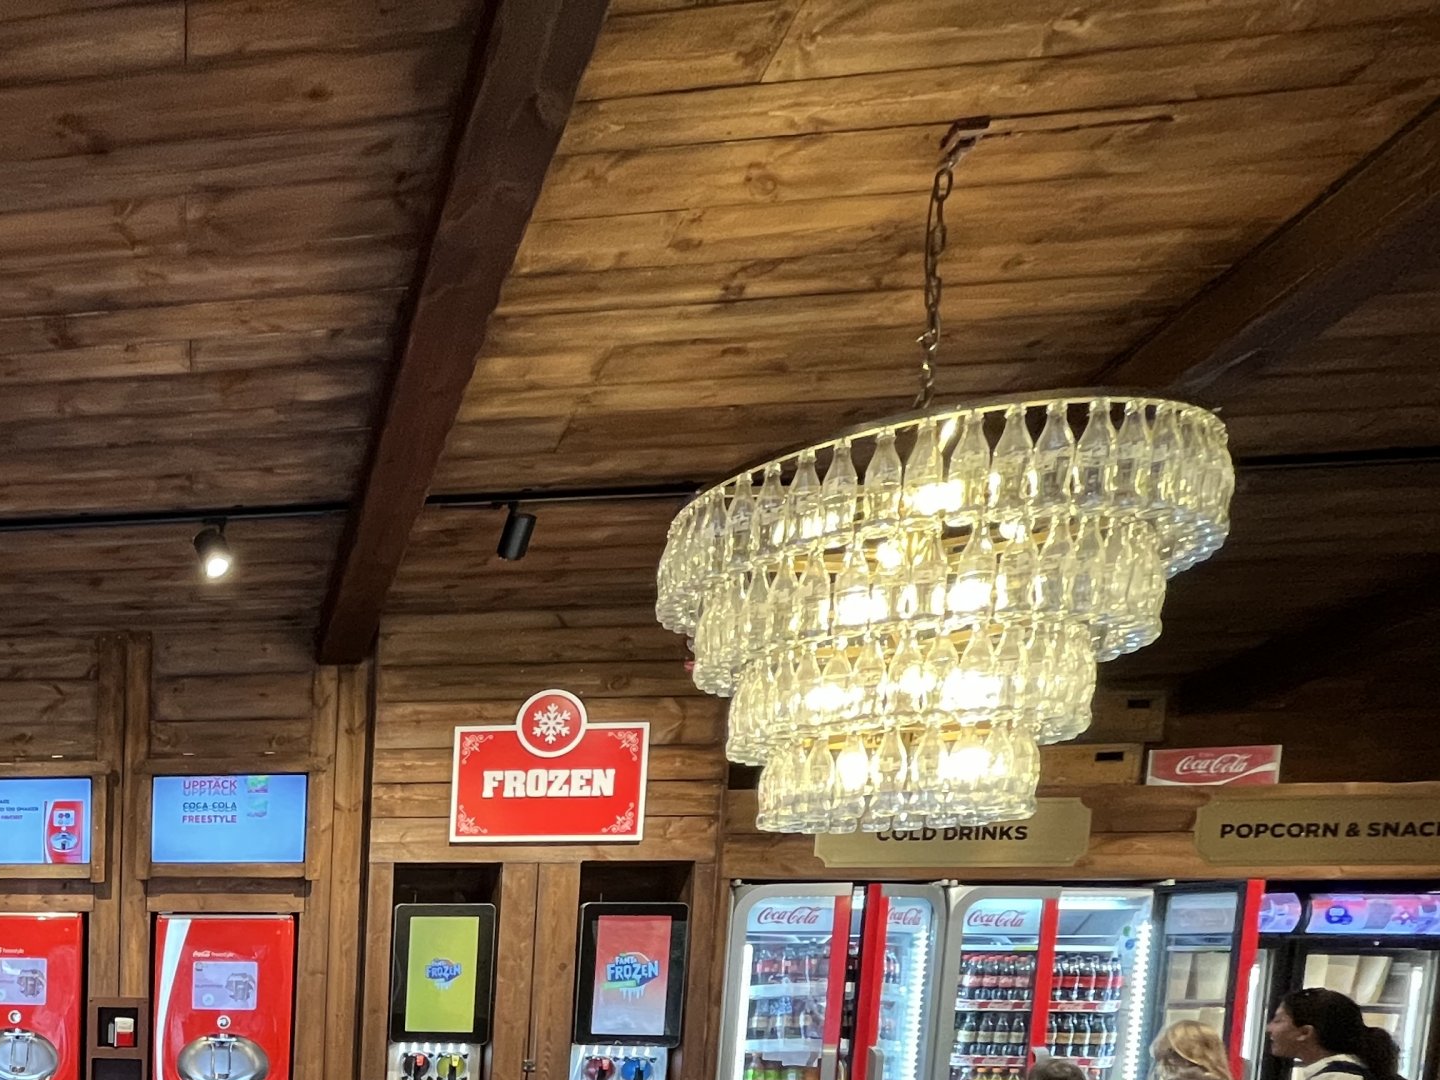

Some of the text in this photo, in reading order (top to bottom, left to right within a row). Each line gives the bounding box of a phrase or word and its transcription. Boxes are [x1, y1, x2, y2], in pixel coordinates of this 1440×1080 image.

[1175, 753, 1253, 775] Coca-Cola
[183, 778, 237, 789] UPPTÄCK
[481, 769, 615, 798] FROZEN
[183, 802, 237, 810] COCA-COLA
[182, 815, 237, 823] FREESTYLE
[876, 825, 1028, 841] COLD DRINKS
[1220, 823, 1340, 838] POPCORN
[1345, 822, 1360, 838] &
[757, 906, 820, 925] Coca-Cola
[967, 909, 1027, 928] Coca-Cola
[426, 963, 461, 979] FROZEN
[607, 959, 658, 981] FROZEN
